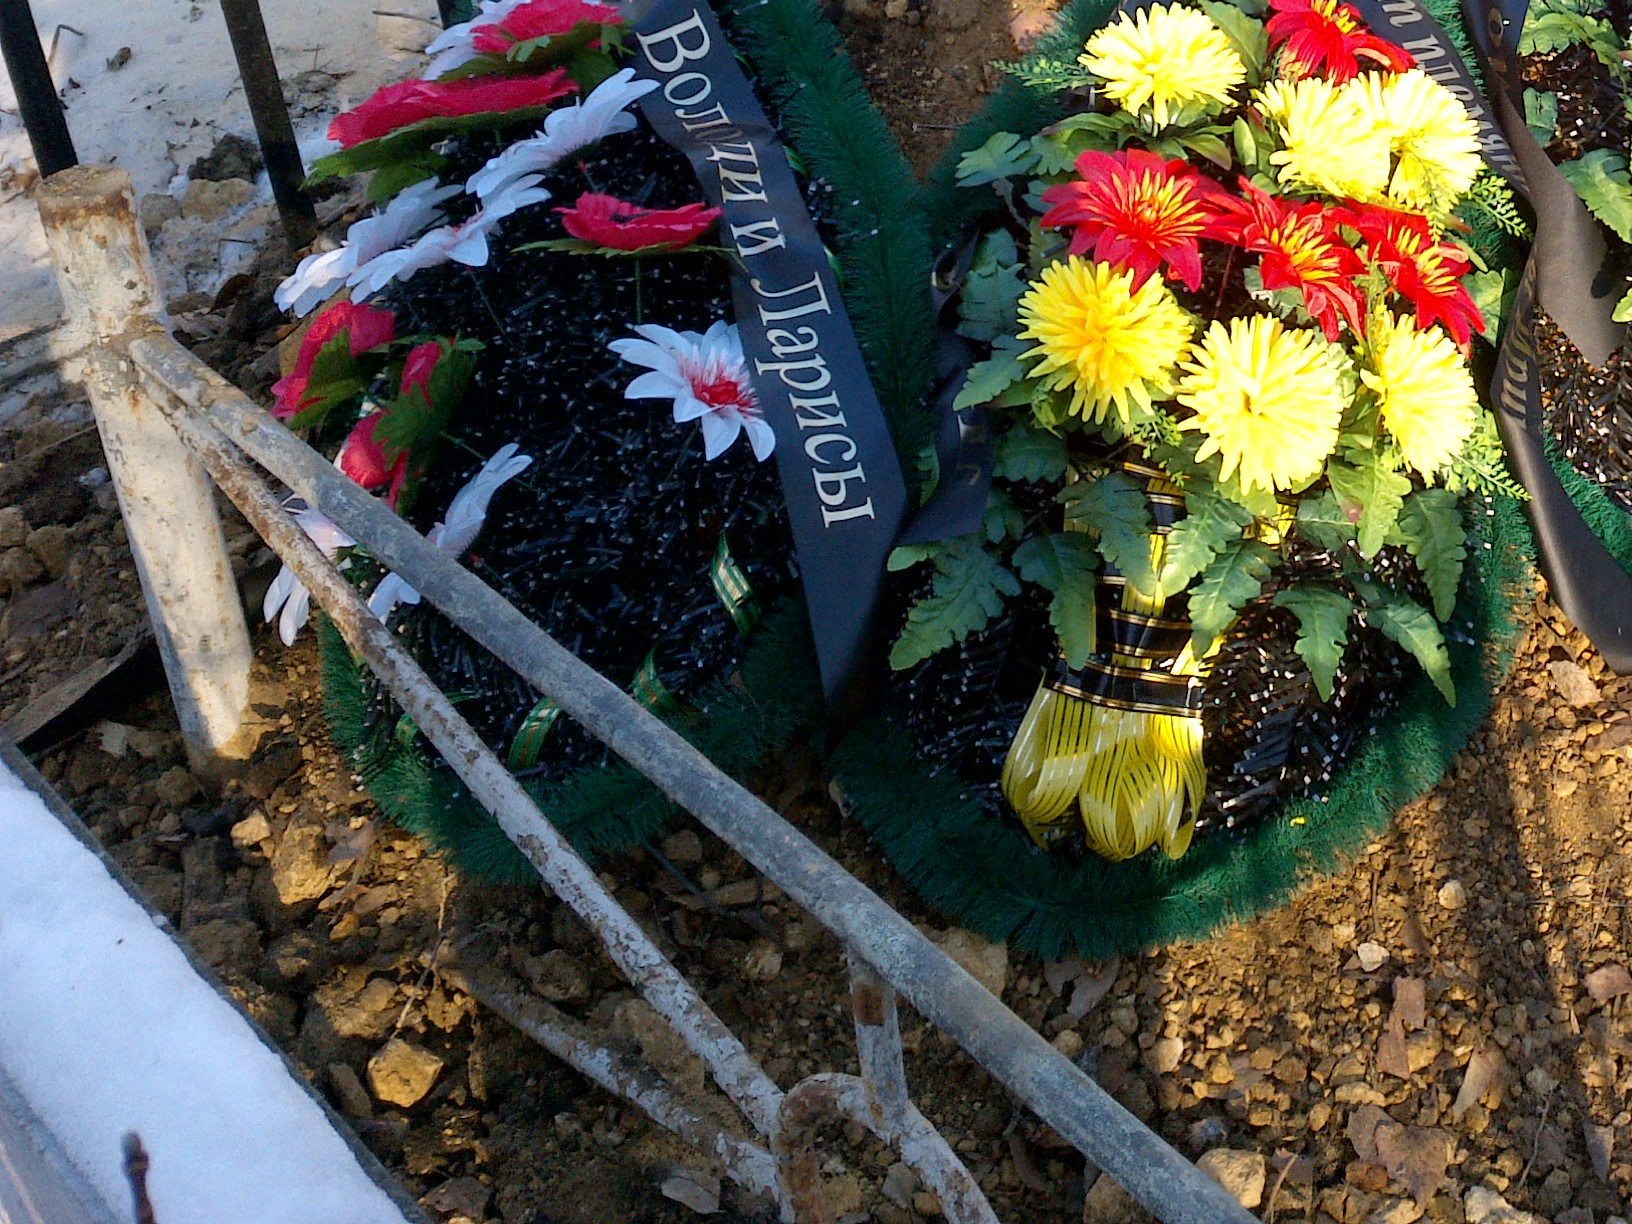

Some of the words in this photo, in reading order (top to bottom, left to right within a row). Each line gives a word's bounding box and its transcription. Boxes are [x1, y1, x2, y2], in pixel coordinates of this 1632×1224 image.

[635, 7, 769, 205] Володи
[729, 215, 787, 258] и
[749, 270, 876, 529] Ларисы
